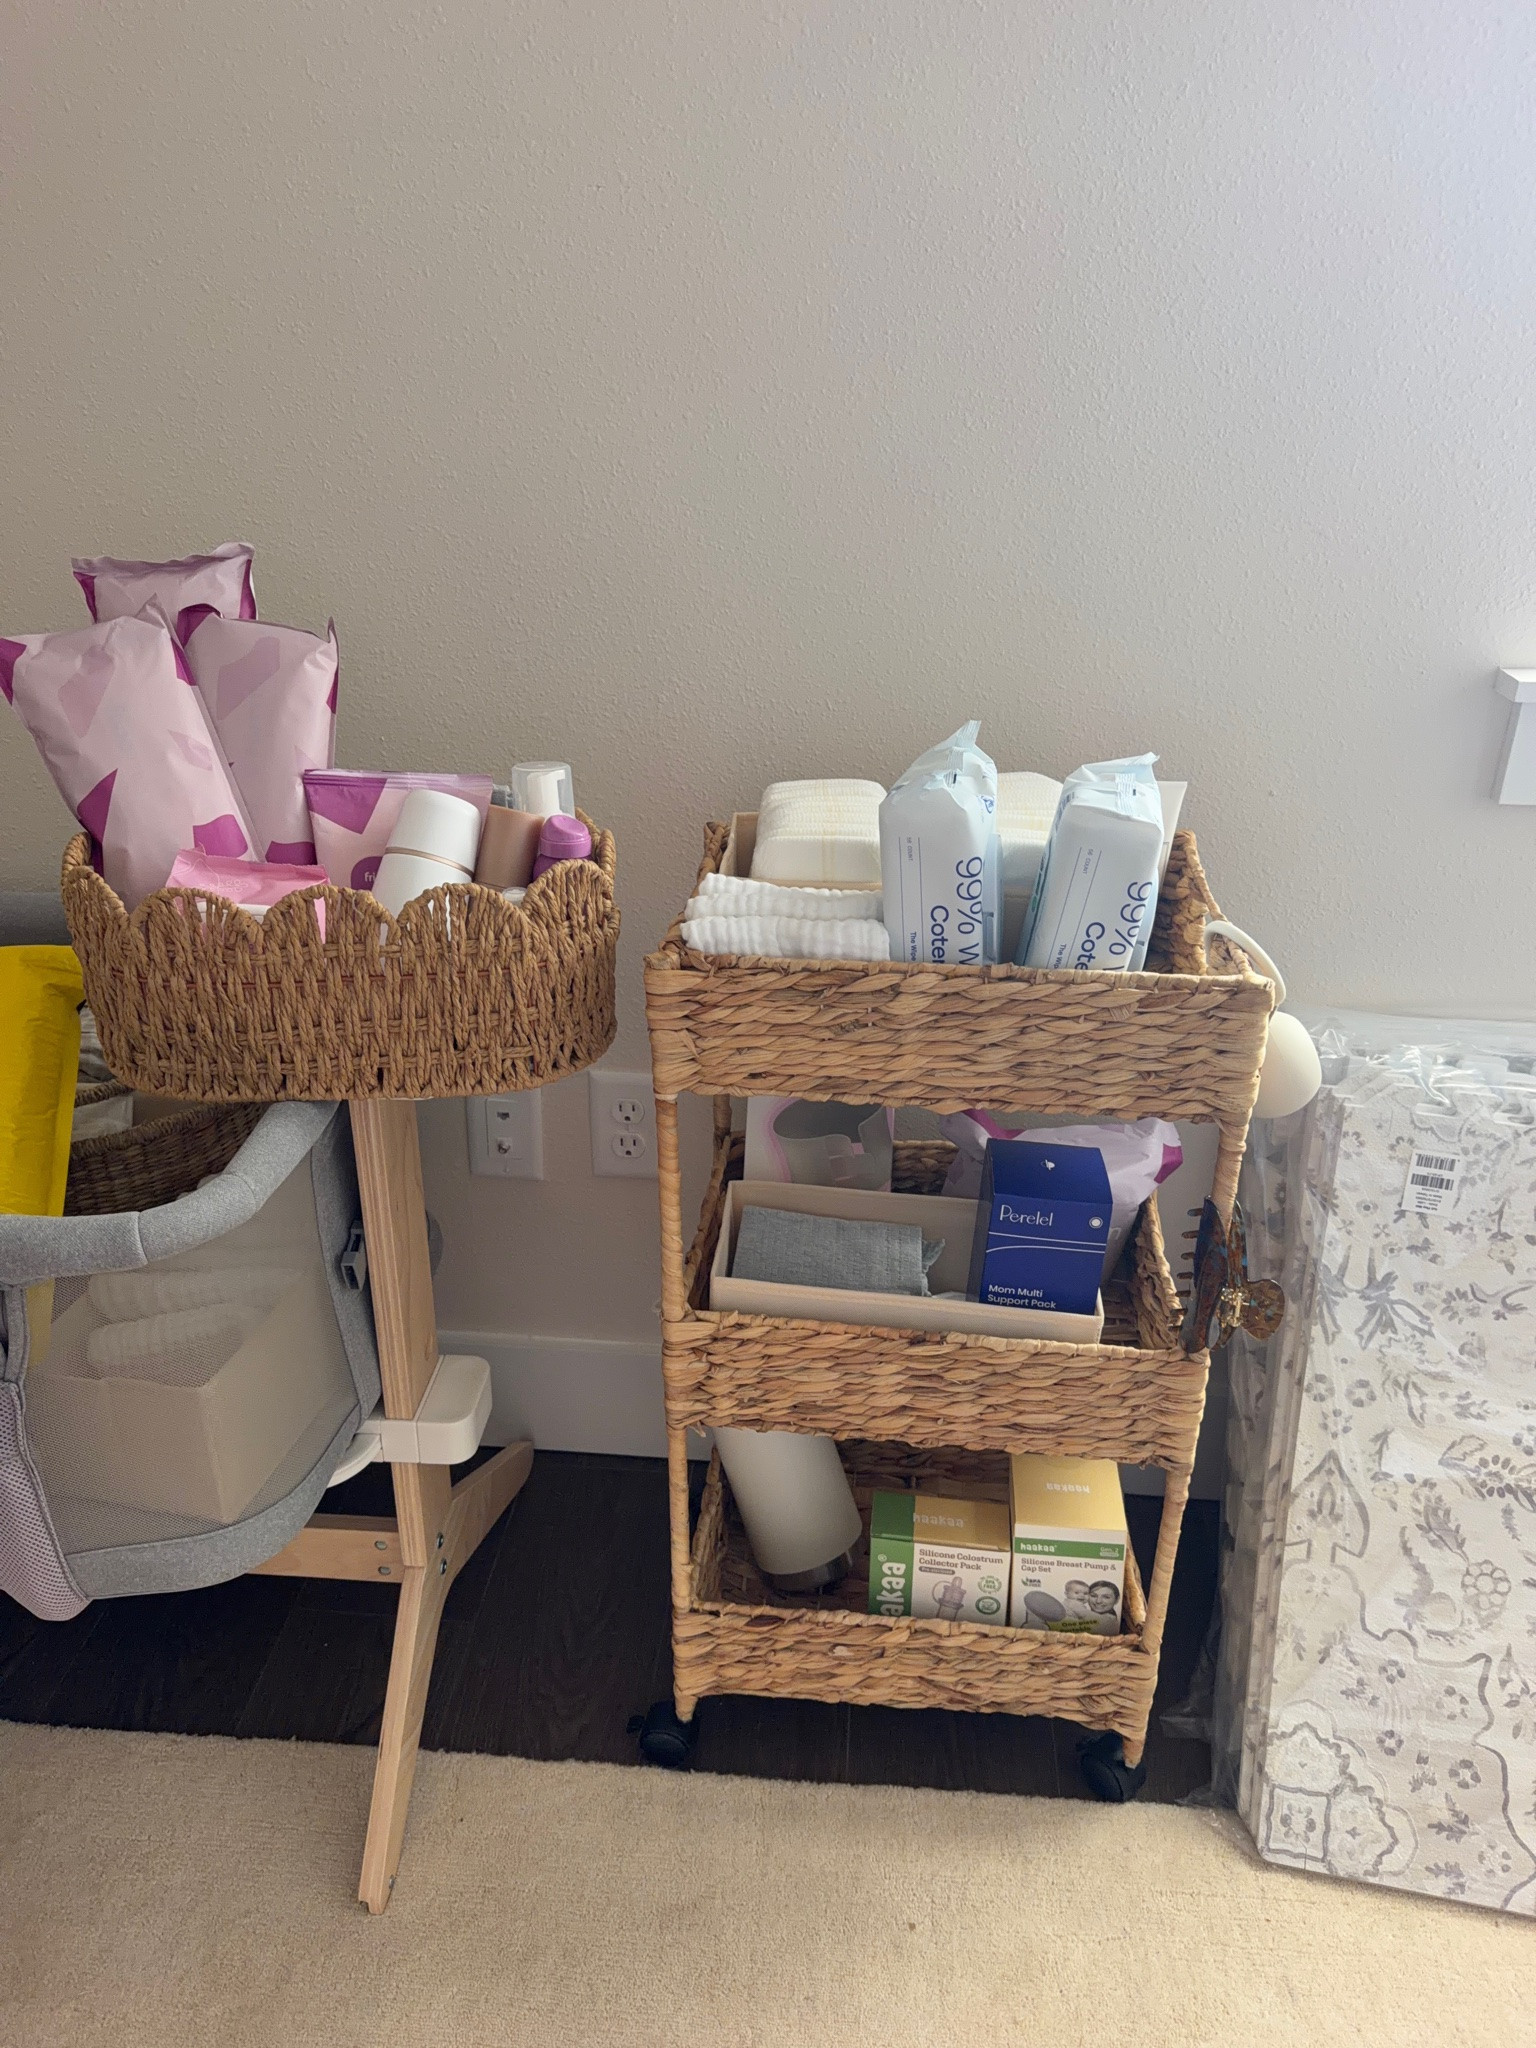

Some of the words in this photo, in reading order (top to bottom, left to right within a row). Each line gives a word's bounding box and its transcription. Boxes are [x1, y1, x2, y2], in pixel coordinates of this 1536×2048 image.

[956, 856, 982, 935] 99%
[1109, 882, 1152, 955] 99%
[1057, 943, 1067, 957] The
[1000, 1204, 1054, 1226] Perelel
[988, 1284, 1016, 1294] Mom
[1017, 1287, 1043, 1297] Multi
[987, 1294, 1030, 1308] Support
[1031, 1299, 1056, 1309] Pack
[919, 1548, 956, 1560] Silicone
[956, 1552, 1004, 1564] Colostrum
[918, 1558, 958, 1568] Collector
[960, 1562, 982, 1571] Pack
[1021, 1558, 1055, 1566] Silicone
[1056, 1560, 1082, 1568] Breast
[1084, 1562, 1109, 1571] Pump
[1021, 1564, 1038, 1573] Cap
